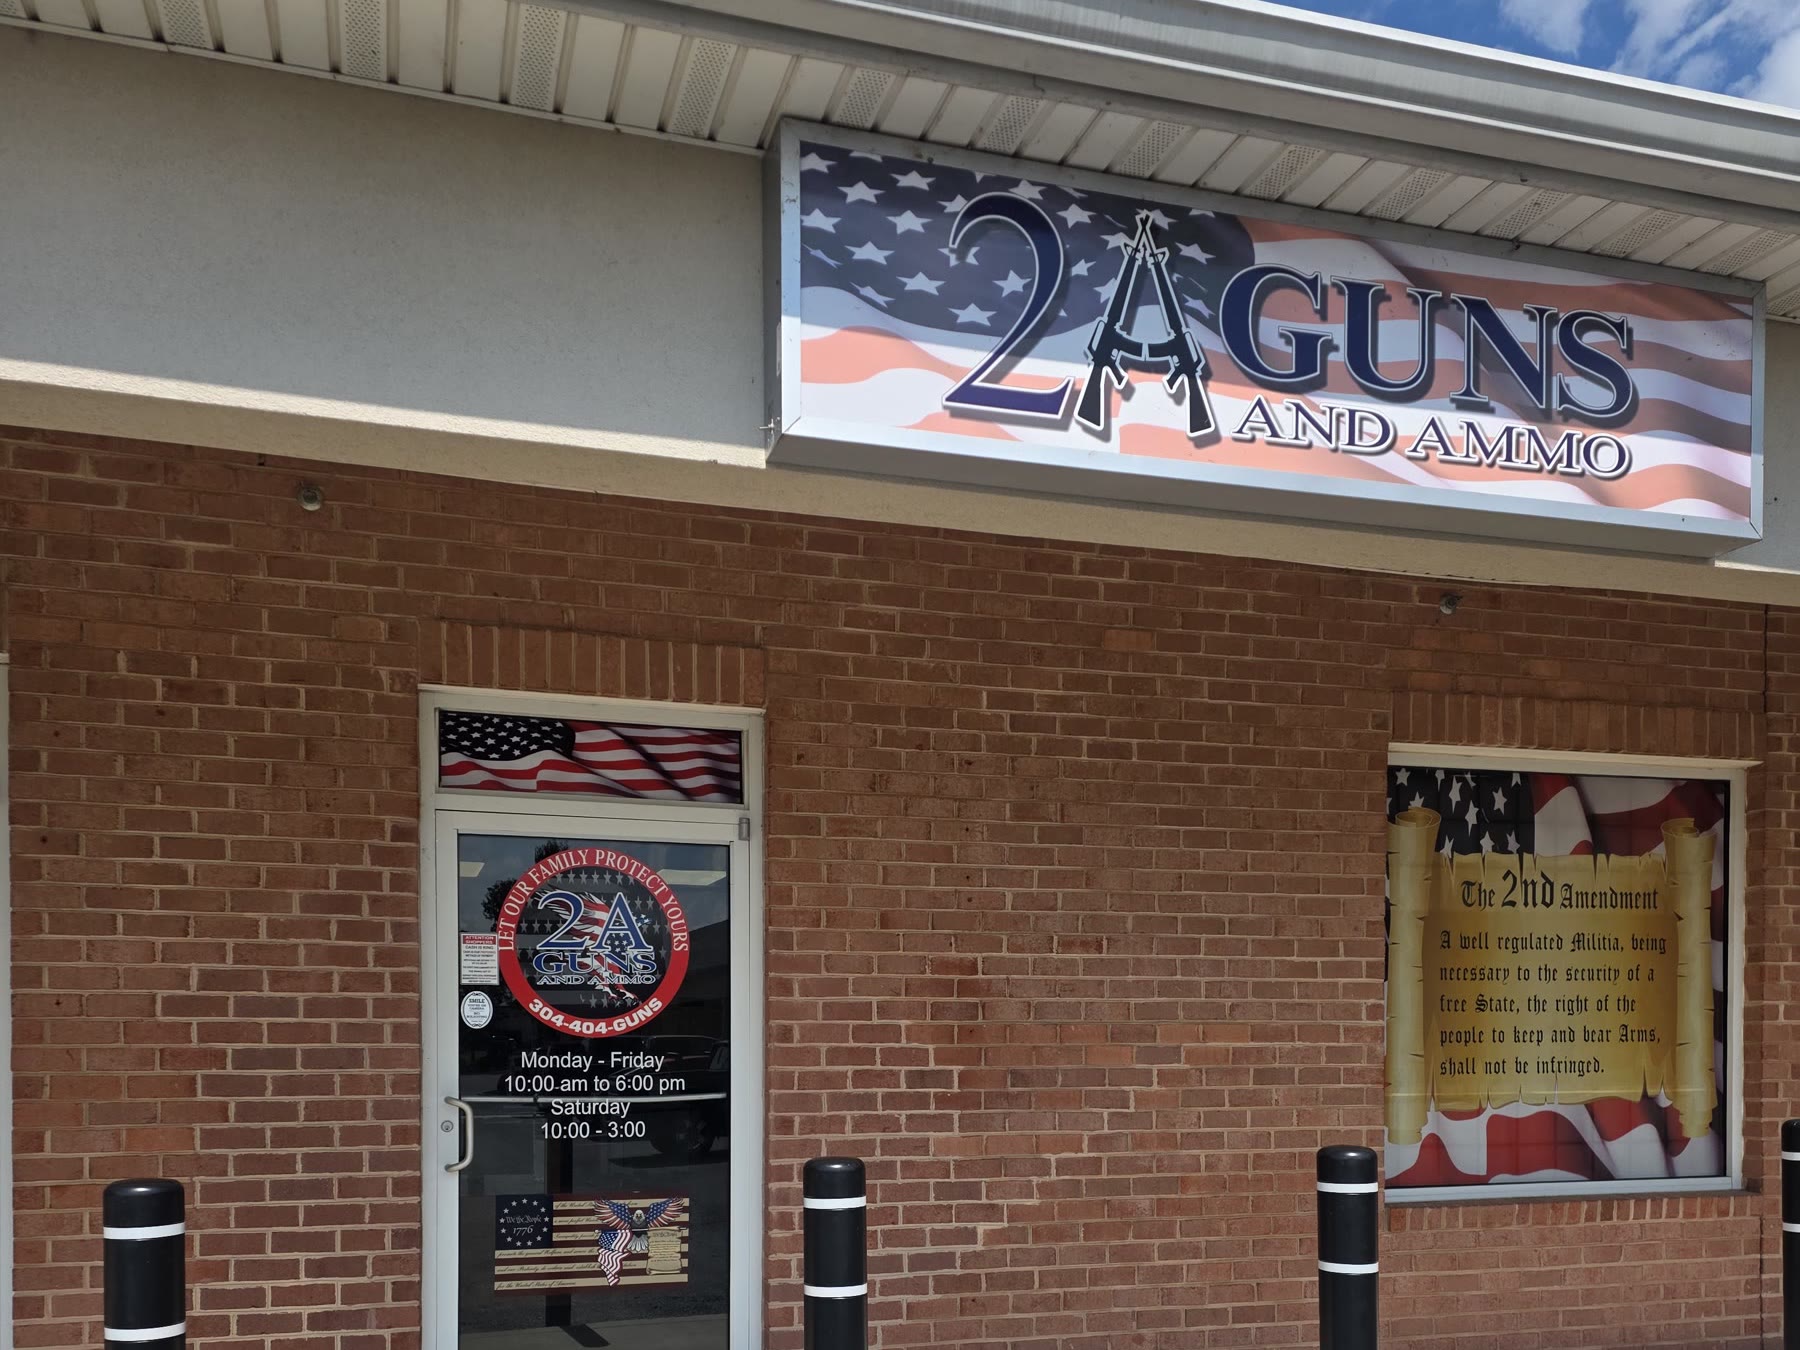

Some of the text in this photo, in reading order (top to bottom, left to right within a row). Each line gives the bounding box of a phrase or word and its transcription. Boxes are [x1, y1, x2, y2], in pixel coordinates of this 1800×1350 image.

[1219, 264, 1634, 419] GUNS
[1231, 396, 1631, 478] AND AMMO
[498, 849, 689, 952] LET OUR FAMILY PROTECT YOURS
[1460, 869, 1659, 911] The 2nd Amendment
[536, 890, 654, 951] 2A
[1440, 930, 1667, 955] A well regulated Militia, being
[533, 951, 657, 974] GUNS
[537, 974, 657, 985] AND AMMO
[1440, 964, 1655, 985] necessary to the security of a
[1440, 993, 1636, 1015] free State, the right of the
[528, 997, 663, 1035] 304-404-GUNS
[1440, 1024, 1661, 1046] people to keep and bear Arms,
[521, 1051, 593, 1072] Monday
[610, 1051, 664, 1072] Friday
[1440, 1056, 1605, 1078] shall not be infringed.
[504, 1075, 686, 1094] 10:00 am to 6:00 pm
[551, 1098, 630, 1118] Saturday
[541, 1122, 590, 1139] 10:00
[607, 1121, 646, 1138] 3:00
[505, 1214, 541, 1223] We the People
[513, 1224, 534, 1236] 1776
